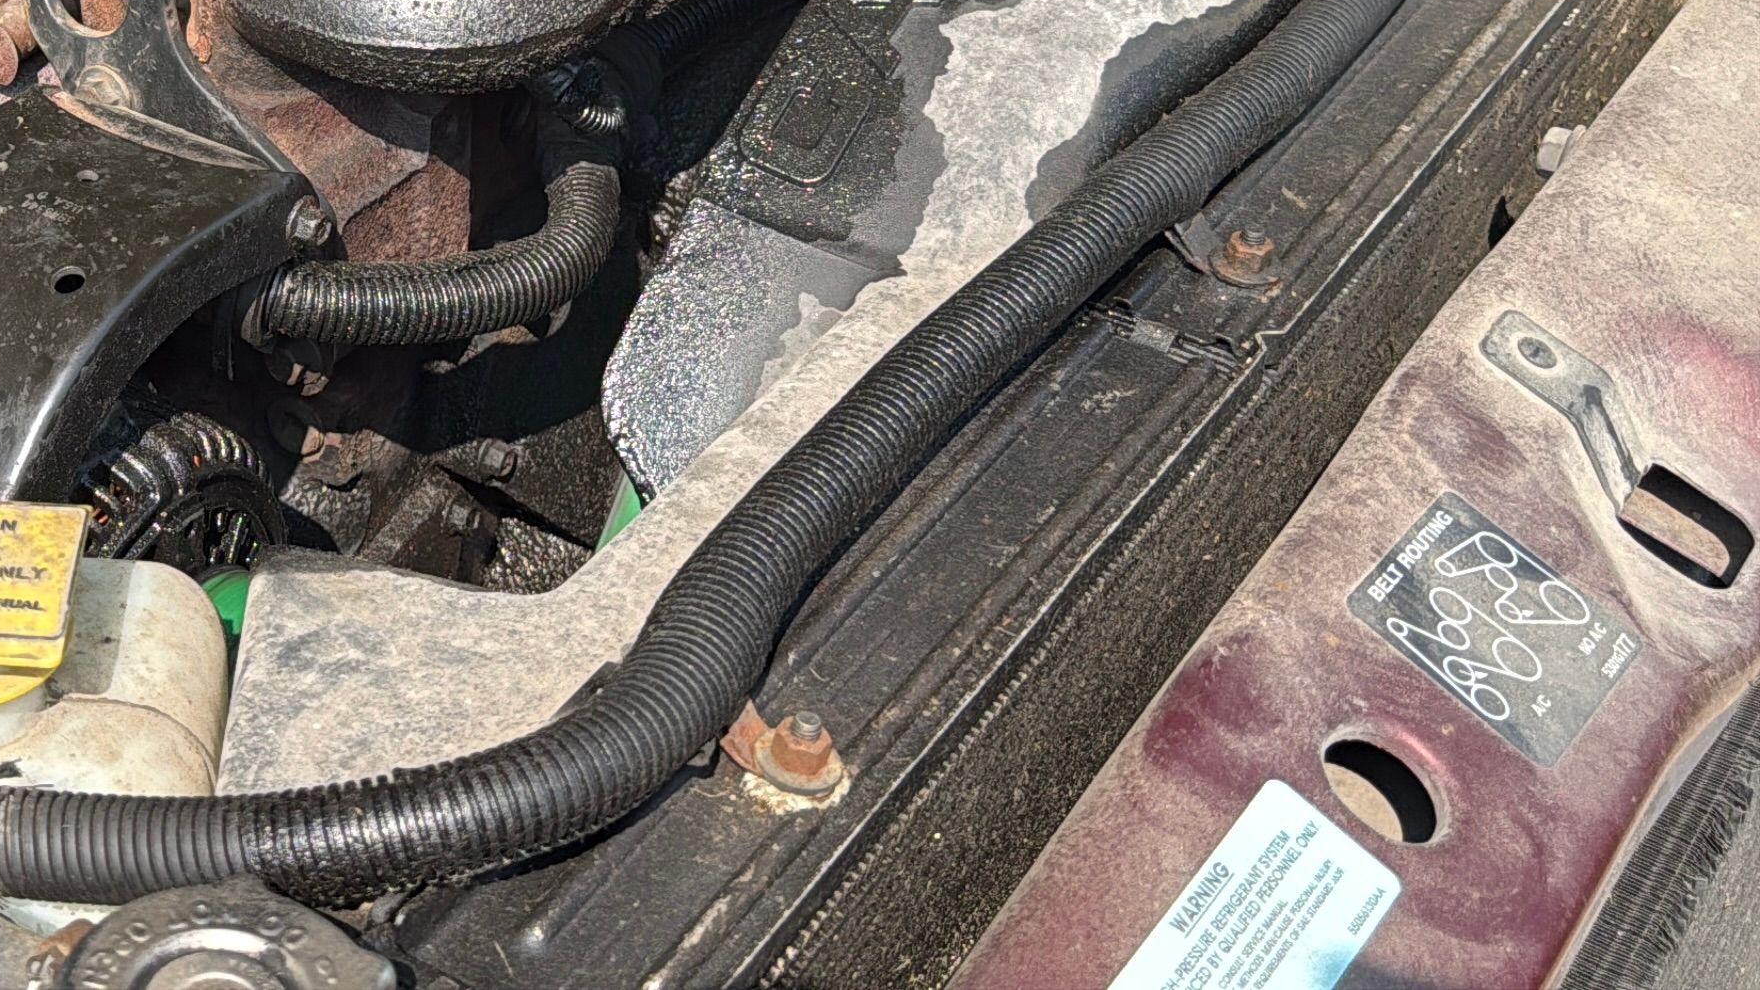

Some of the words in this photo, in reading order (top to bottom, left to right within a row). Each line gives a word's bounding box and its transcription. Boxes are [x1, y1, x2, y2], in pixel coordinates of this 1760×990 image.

[1366, 562, 1406, 603] BELT
[1395, 507, 1454, 570] ROUTING
[1576, 636, 1597, 655] NO
[1167, 859, 1233, 934] WARNING
[1208, 863, 1266, 932] REFRIGERANT
[1255, 829, 1291, 869] SYSTEM
[1252, 844, 1303, 903] PERSONNEL
[1303, 881, 1335, 918] STANDARD
[1214, 897, 1264, 954] QUALIFIED
[1235, 953, 1267, 989] METHODS
[1271, 913, 1295, 940] CAUSE
[1287, 880, 1319, 916] PERSONAL
[1287, 927, 1302, 941] OF
[1294, 914, 1312, 931] SAE
[1204, 949, 1225, 969] BY
[1216, 955, 1246, 990] CONSULT
[1239, 926, 1267, 958] SERVICE
